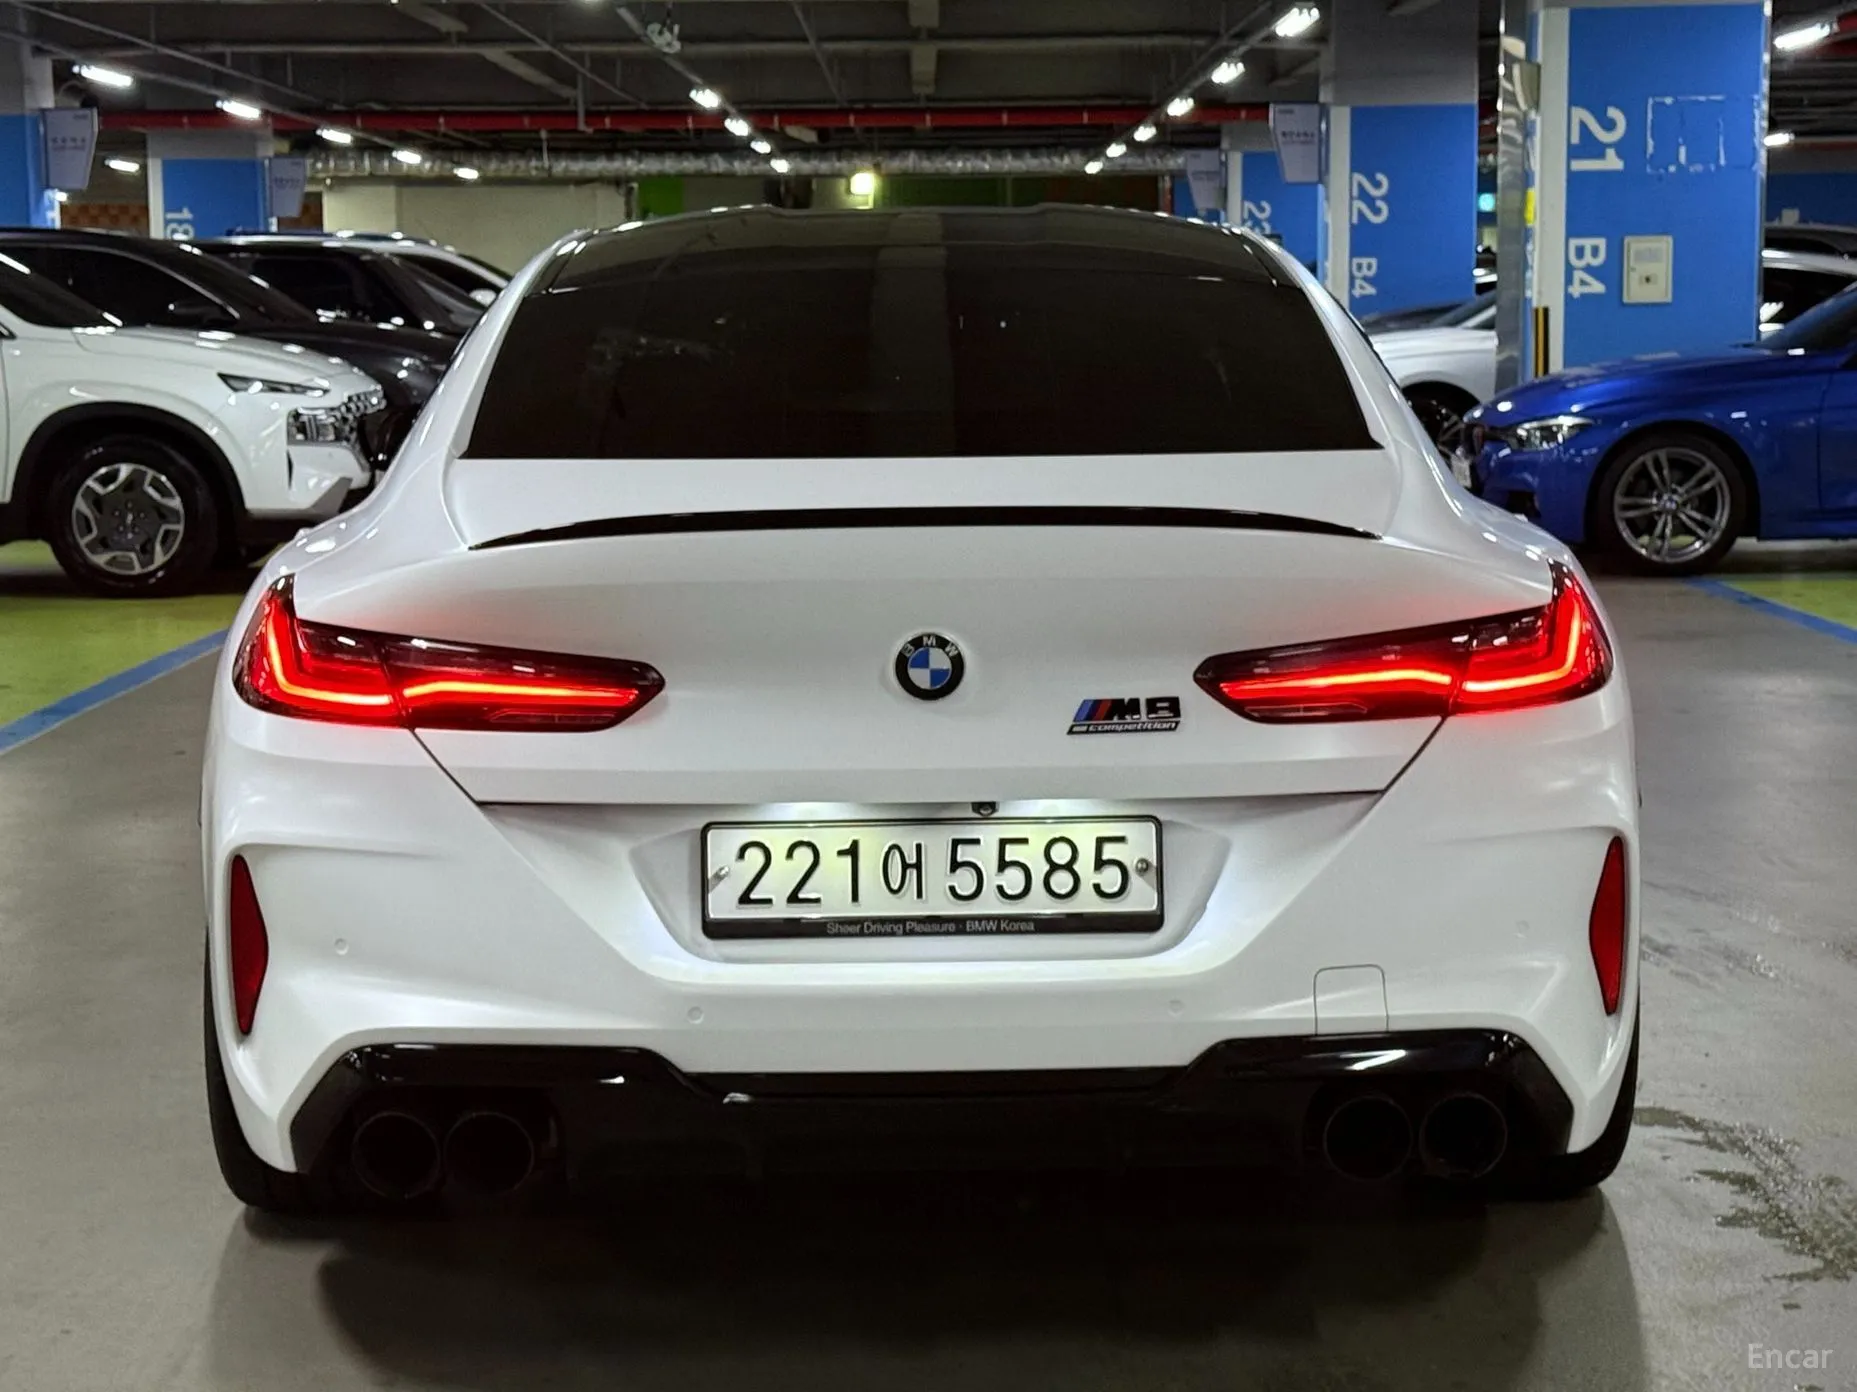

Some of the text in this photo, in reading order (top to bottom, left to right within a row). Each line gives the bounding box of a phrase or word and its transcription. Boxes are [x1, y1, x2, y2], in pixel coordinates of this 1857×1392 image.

[1567, 106, 1628, 299] 21 B4
[1351, 172, 1390, 299] 22 B4
[900, 634, 959, 658] BMW
[1088, 721, 1178, 733] competition
[735, 836, 1130, 906] 221어 5585
[826, 920, 1035, 935] Sheer Driving Pleasure BMW Korea
